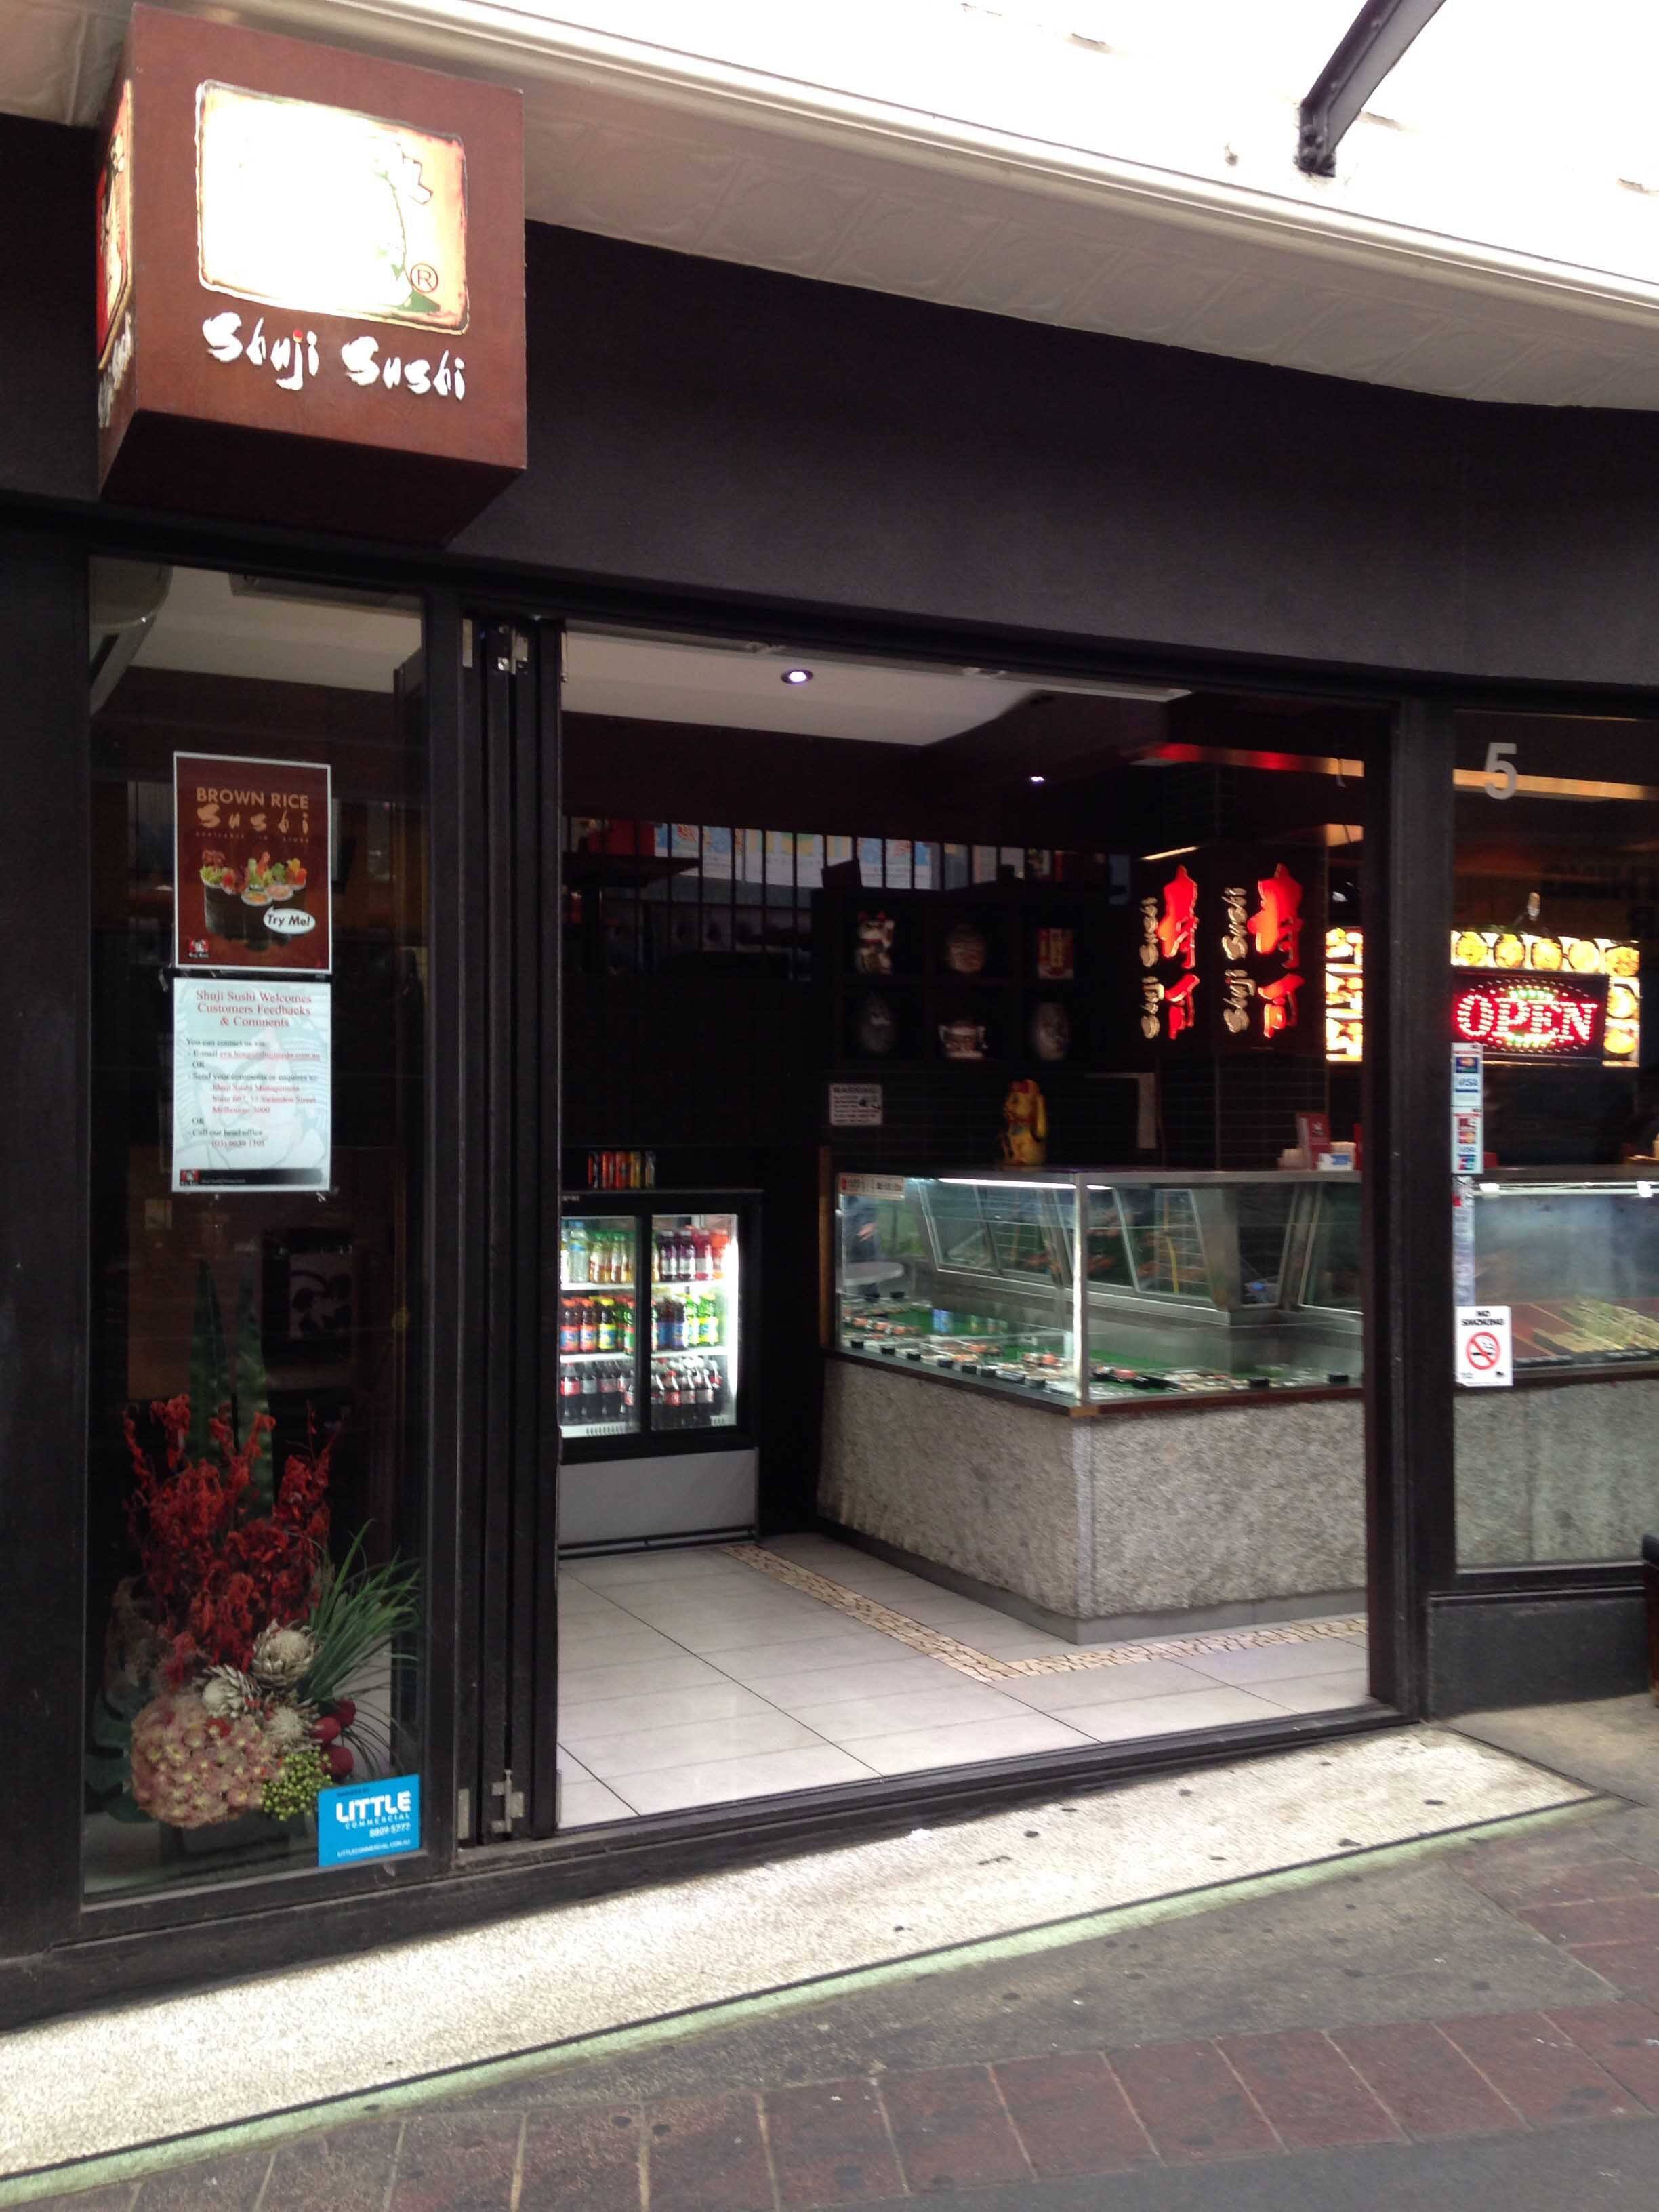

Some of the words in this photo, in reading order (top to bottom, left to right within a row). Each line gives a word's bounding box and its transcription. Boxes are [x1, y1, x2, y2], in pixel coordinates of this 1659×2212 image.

[203, 311, 319, 390] Shuji
[341, 336, 466, 400] Sushi
[1483, 743, 1518, 800] 5
[196, 787, 264, 806] BROWN
[271, 792, 309, 810] RICE
[197, 803, 309, 834] Sushi
[266, 915, 285, 927] Try
[289, 915, 310, 927] Me!
[1221, 887, 1248, 960] Sushi
[196, 990, 224, 1002] Shuji
[227, 991, 255, 1002] Sushi
[260, 992, 312, 1004] Welcomes
[197, 1002, 253, 1014] Customers
[258, 1004, 311, 1016] Feedbacks
[1223, 969, 1256, 1033] Shuji
[220, 1017, 229, 1026] &
[233, 1016, 290, 1027] Comments
[1456, 994, 1598, 1042] OPEN
[1461, 1318, 1505, 1326] SMOKING
[336, 1790, 412, 1824] LITTLE
